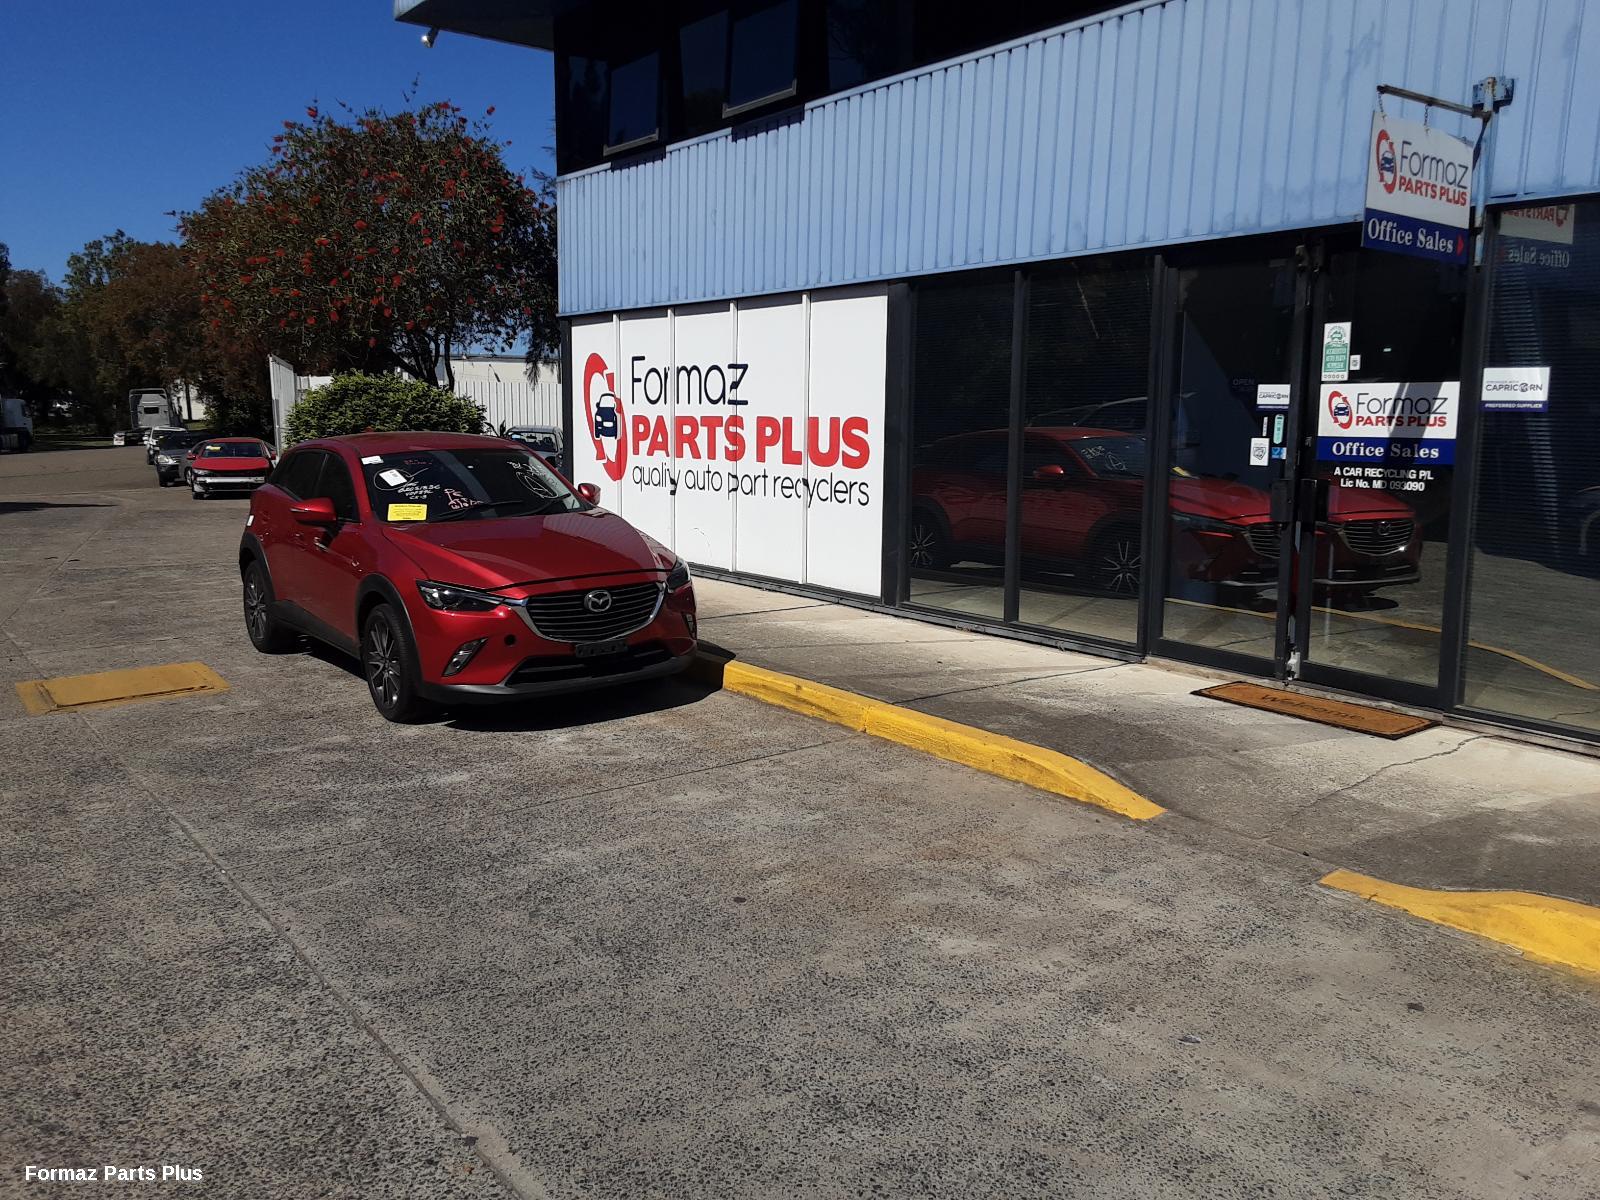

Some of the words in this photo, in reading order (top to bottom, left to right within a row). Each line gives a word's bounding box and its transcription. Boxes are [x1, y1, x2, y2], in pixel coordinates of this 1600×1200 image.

[1400, 140, 1469, 190] Formaz
[1398, 175, 1438, 200] PARTS
[1439, 184, 1467, 207] PLUS
[1367, 218, 1412, 245] Office
[1416, 227, 1454, 253] Sales
[631, 356, 749, 406] Formaz
[1485, 382, 1543, 392] CAPRICORN
[1356, 392, 1448, 415] Formaz
[1355, 415, 1404, 427] PARTS
[1407, 416, 1447, 428] PLUS
[631, 414, 747, 462] PARTS
[755, 416, 871, 470] PLUS
[1332, 441, 1385, 458] Office
[1390, 442, 1440, 459] Sales
[632, 462, 681, 496] qualiy
[684, 464, 723, 492] auto
[728, 468, 769, 500] part
[773, 472, 870, 508] recyclers
[1333, 466, 1341, 476] A
[1342, 467, 1363, 477] CAR
[1364, 468, 1417, 480] RECYCLING
[1418, 470, 1434, 481] P/L
[1340, 478, 1354, 487] Lic
[1355, 479, 1370, 488] No.
[1372, 480, 1387, 489] MD
[1390, 481, 1425, 491] 093090
[1261, 693, 1365, 720] Welcome
